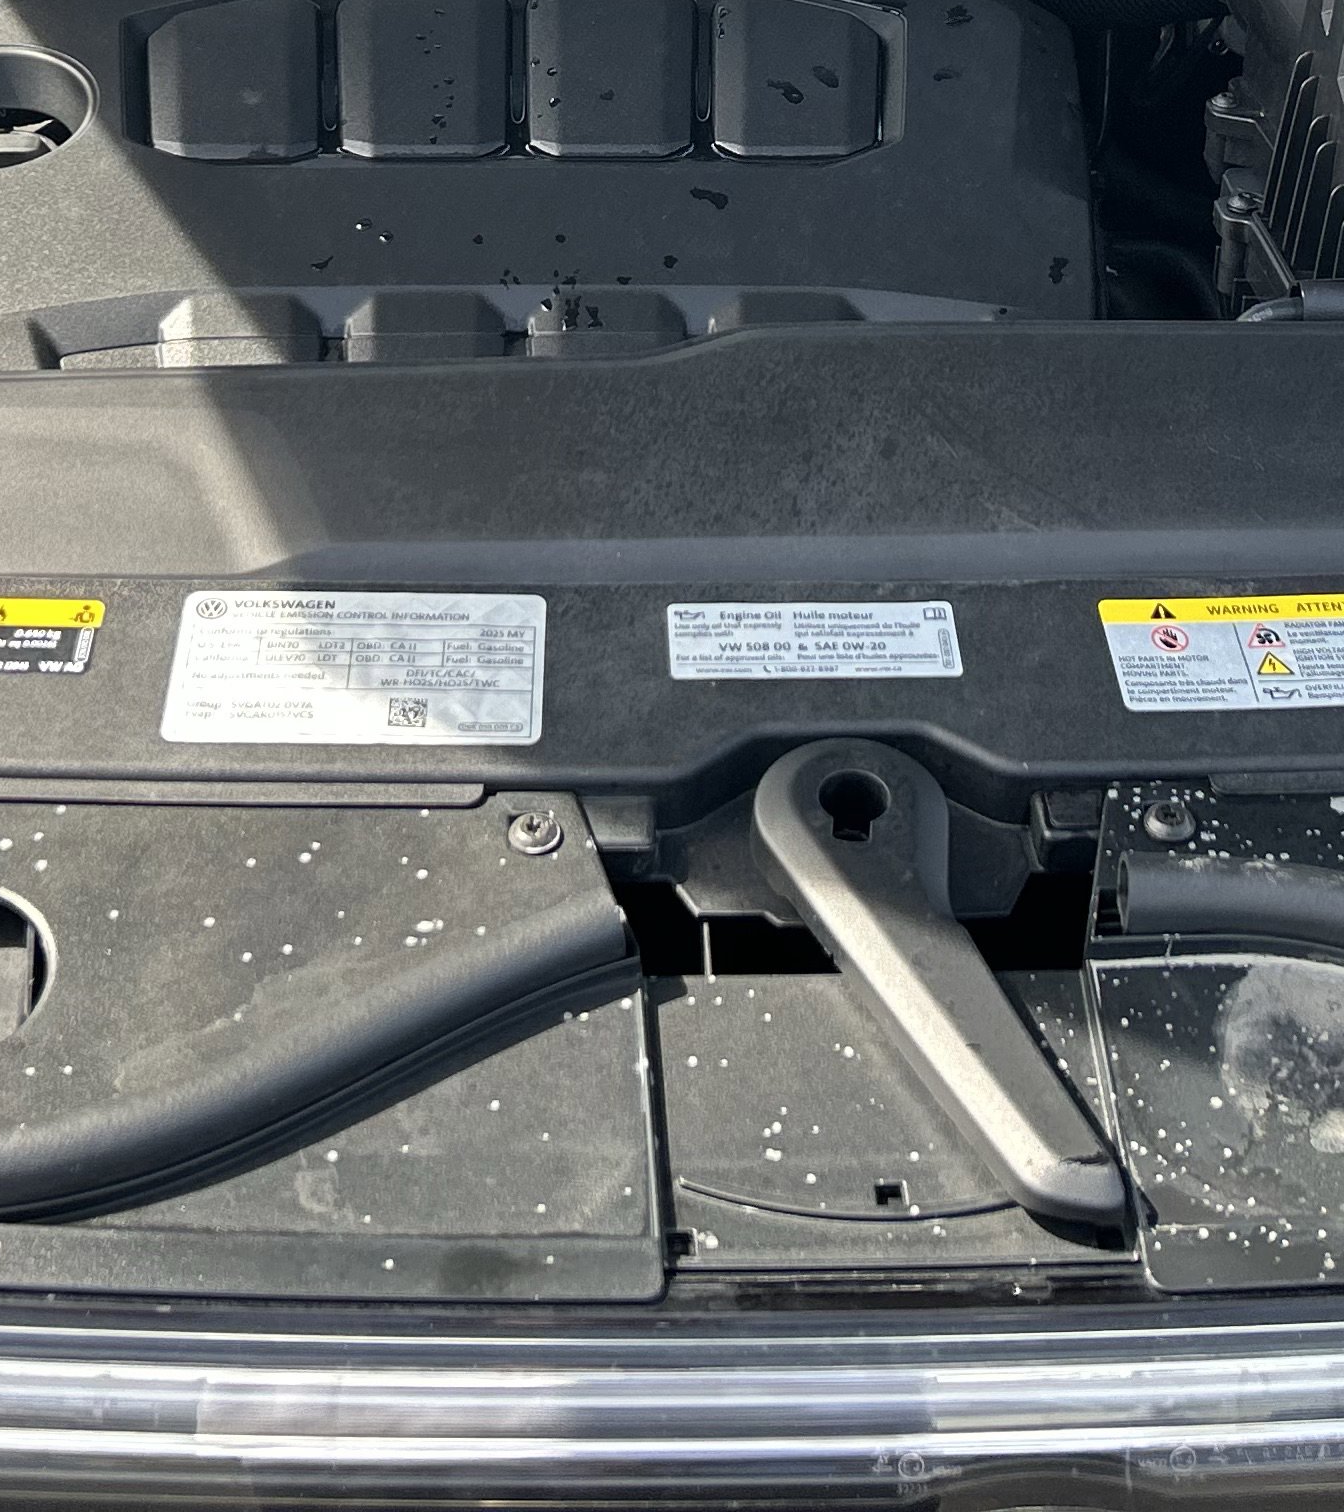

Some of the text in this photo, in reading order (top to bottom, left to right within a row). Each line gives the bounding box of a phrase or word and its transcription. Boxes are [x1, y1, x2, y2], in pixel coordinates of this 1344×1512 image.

[235, 600, 336, 609] VOLKSWAGEN
[793, 610, 874, 620] Huile moteur
[1206, 604, 1280, 616] WARNING
[280, 611, 334, 620] EMISSION
[337, 611, 388, 620] CONTROL
[392, 612, 470, 621] INFORMATION
[720, 610, 782, 622] Engine Oil
[48, 630, 62, 640] kg
[480, 629, 526, 638] 2025 MY
[478, 643, 524, 652] Gasoline
[718, 641, 886, 652] VW 508 00 & SAE 0W-20
[1294, 648, 1314, 656] HIGH
[477, 656, 524, 665] Gasoline
[38, 661, 85, 672] VW AG
